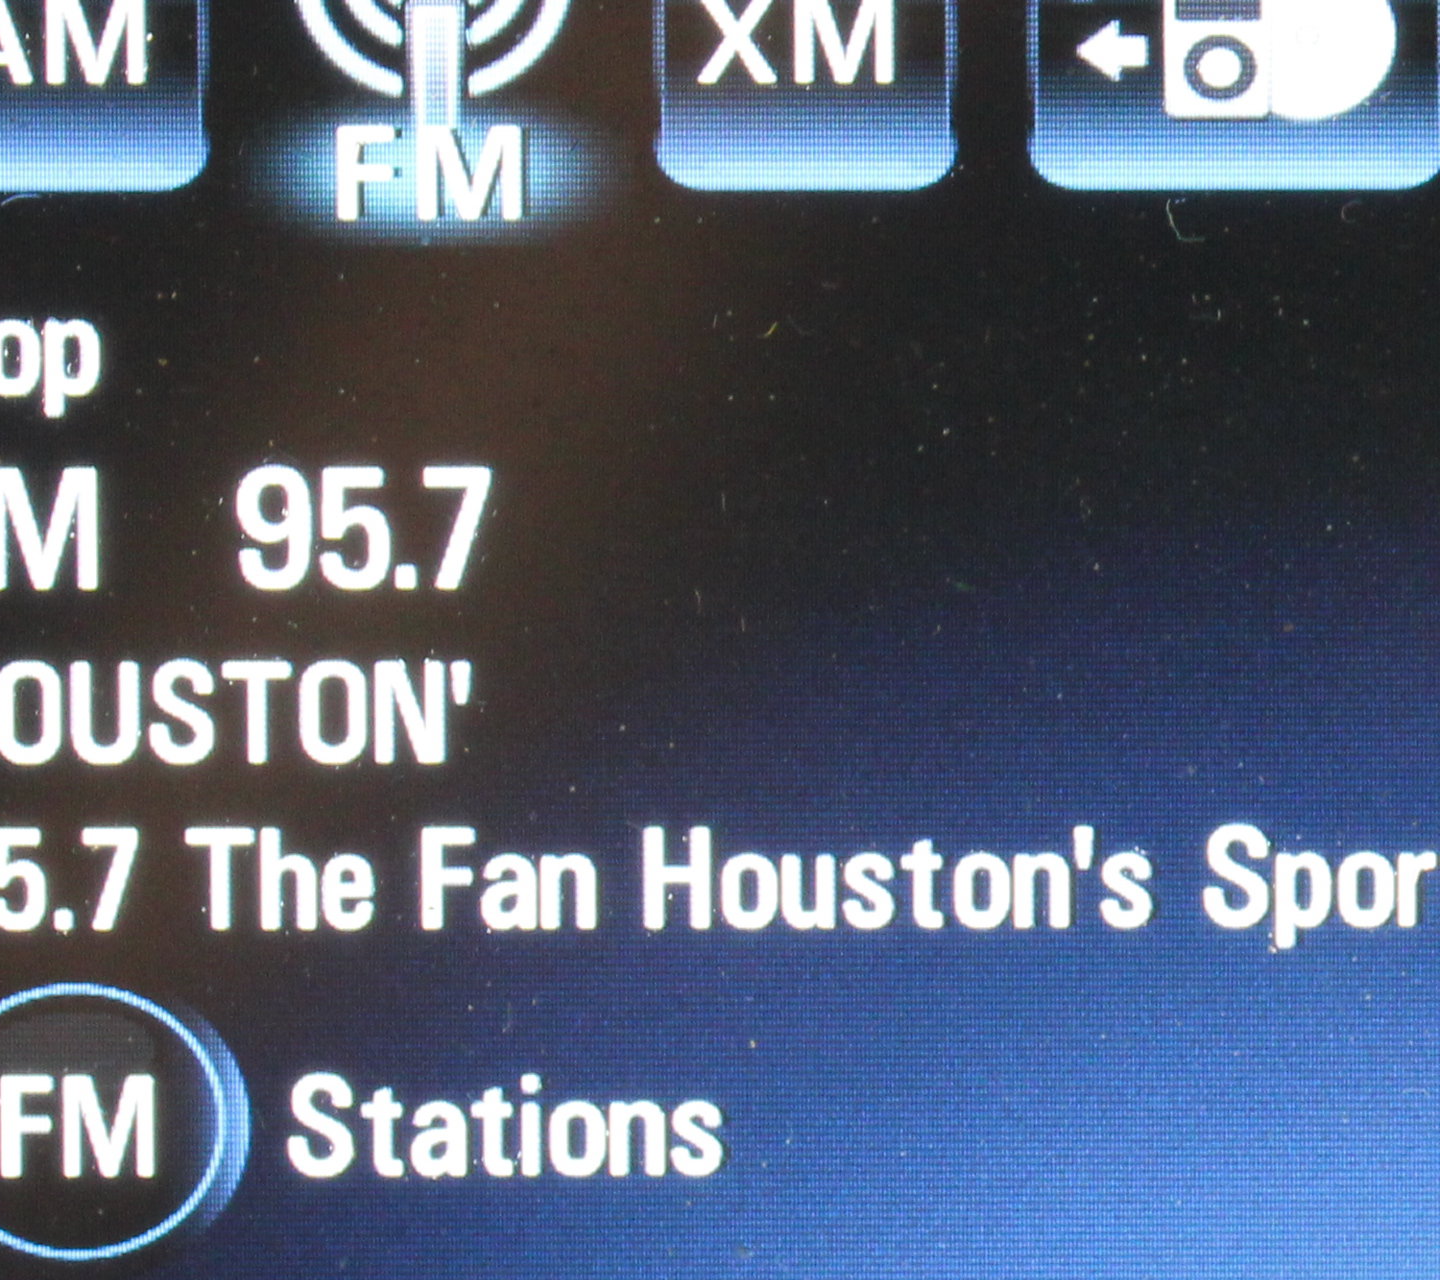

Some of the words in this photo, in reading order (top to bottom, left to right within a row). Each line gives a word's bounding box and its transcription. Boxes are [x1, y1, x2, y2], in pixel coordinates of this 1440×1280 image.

[334, 124, 526, 221] FM
[235, 465, 493, 591] 95.7
[186, 826, 373, 932] The
[419, 826, 599, 932] Fan
[640, 826, 1154, 932] Houston's
[286, 1076, 725, 1182] Stations
